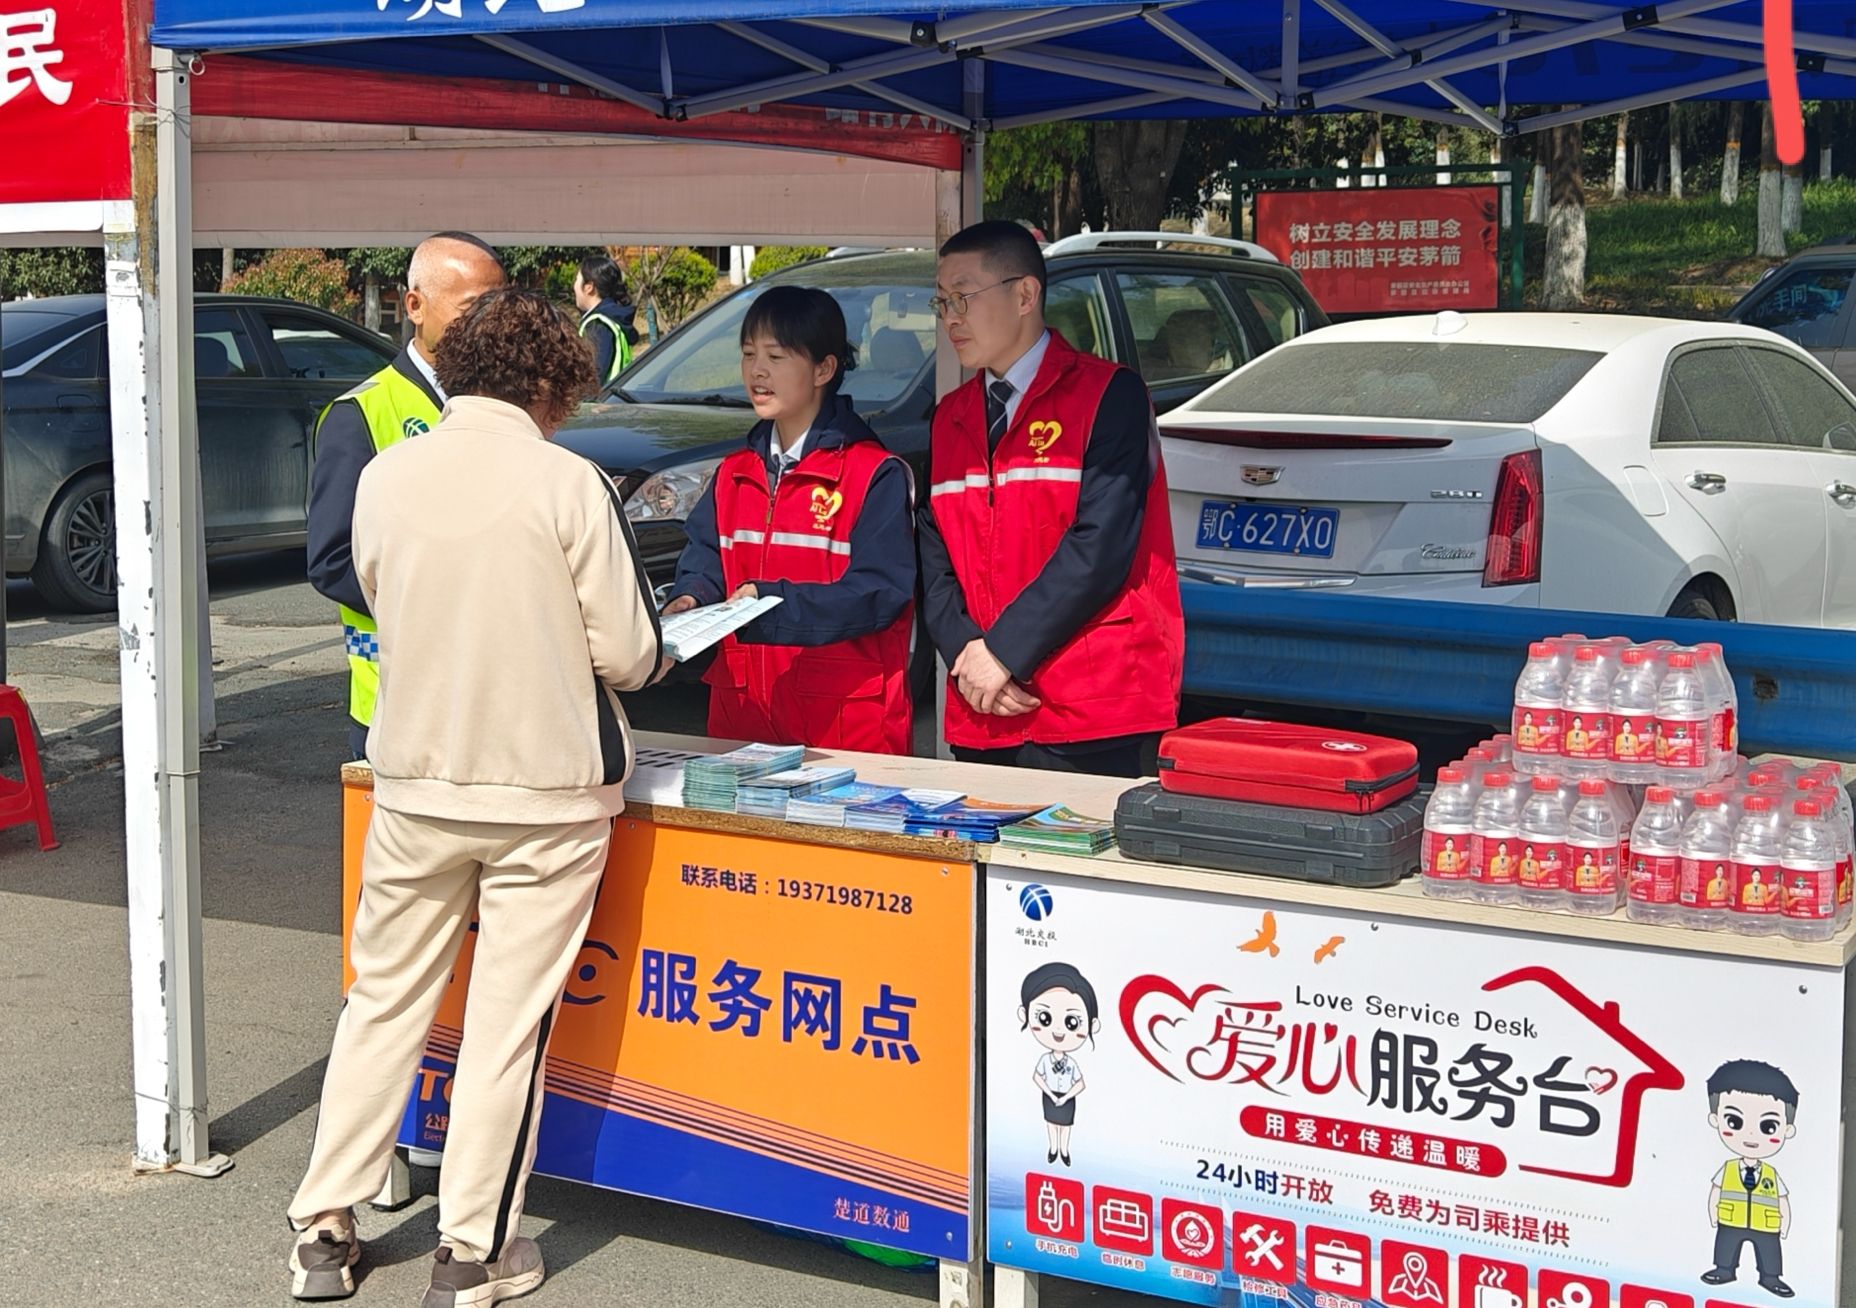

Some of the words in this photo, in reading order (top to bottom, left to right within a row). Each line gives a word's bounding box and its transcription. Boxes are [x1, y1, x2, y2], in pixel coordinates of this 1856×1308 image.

[0, 7, 74, 106] 民
[1289, 218, 1462, 244] 树立安全发展理念
[1290, 245, 1462, 270] 创建和谐平安茅箭
[637, 948, 921, 1065] 服务网点
[1296, 985, 1353, 1012] Love
[1366, 995, 1460, 1027] Service
[1474, 1010, 1538, 1039] Desk
[1187, 1000, 1617, 1137] 爱心服务台
[1265, 1112, 1481, 1172] 用爱心传递温暖
[833, 1197, 910, 1233] 楚道数通
[1196, 1159, 1334, 1206] 24小时开放
[1368, 1189, 1571, 1248] 免费为司乘提供
[1037, 1240, 1078, 1257] 手机充电
[1102, 1253, 1145, 1270] 临时休息
[1172, 1267, 1215, 1284] 志愿服务
